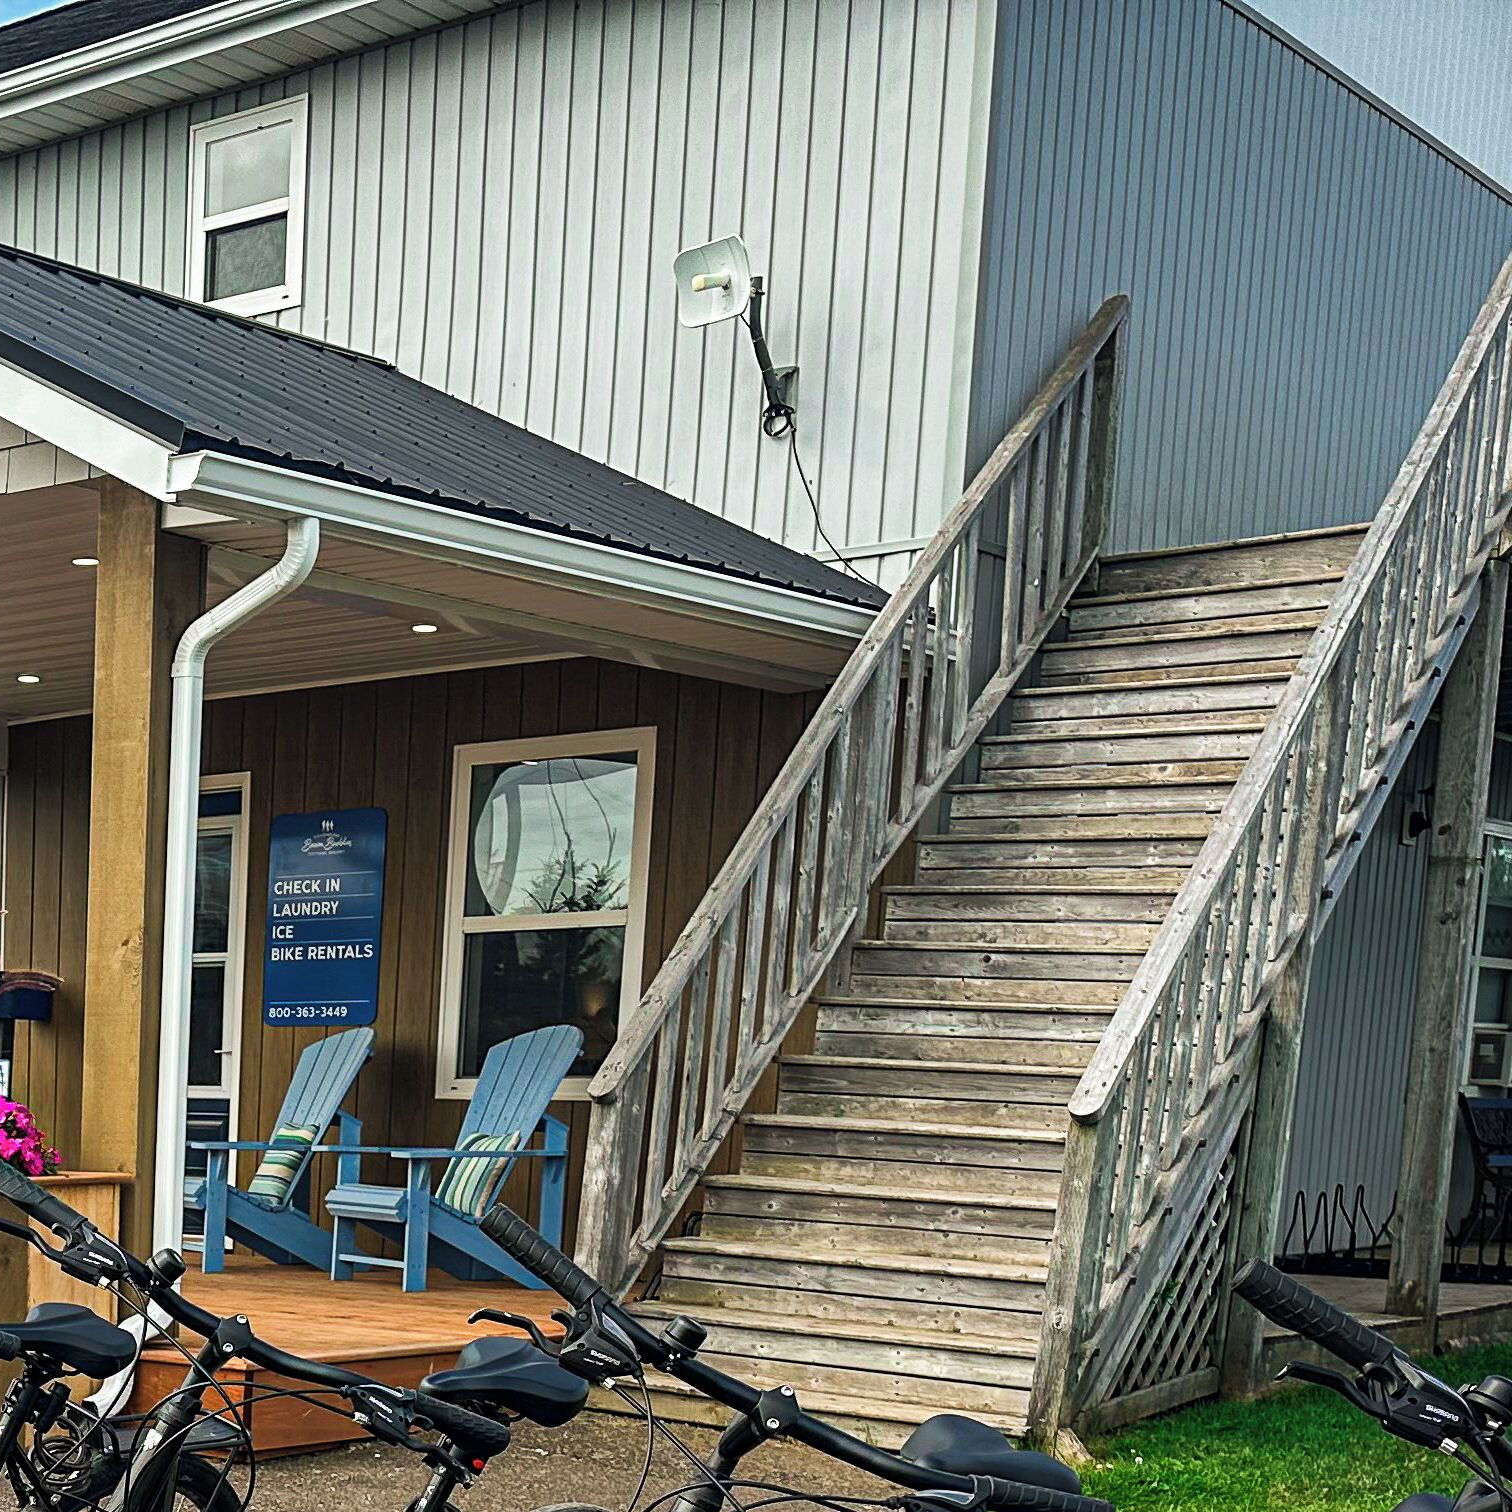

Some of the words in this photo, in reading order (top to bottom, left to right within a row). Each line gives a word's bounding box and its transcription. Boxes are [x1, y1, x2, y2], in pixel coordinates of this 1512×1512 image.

[274, 879, 320, 895] CHECK
[325, 878, 340, 892] IN
[273, 901, 339, 917] LAUNDRY
[272, 925, 294, 939] ICE
[271, 946, 303, 961] BIKE
[307, 944, 373, 960] RENTALS
[268, 1006, 347, 1018] 800-363-3449
